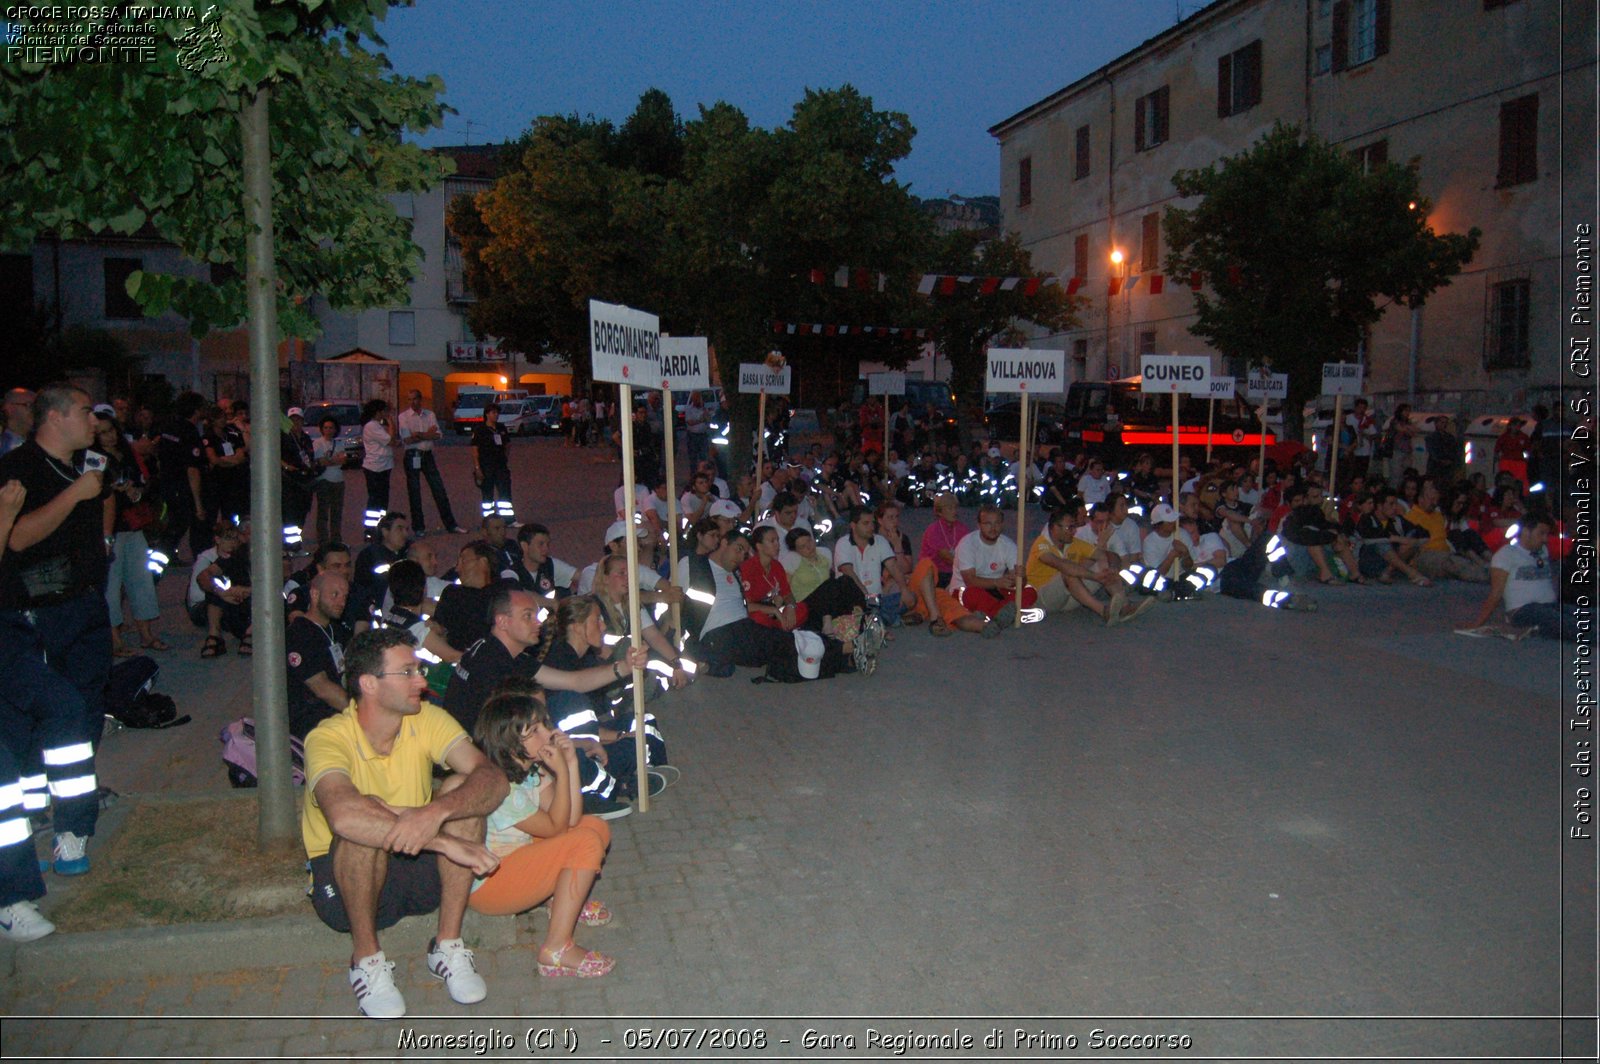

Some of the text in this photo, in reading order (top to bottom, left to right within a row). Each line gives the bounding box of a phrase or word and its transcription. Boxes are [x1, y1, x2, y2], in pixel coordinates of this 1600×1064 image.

[593, 319, 660, 362] BORGOMANERO
[990, 360, 1057, 380] VILLANOVA
[1143, 364, 1204, 381] CUNEO
[742, 373, 758, 386] BASSA
[765, 374, 784, 386] SCRIVIA
[1249, 379, 1283, 390] BASILICATA
